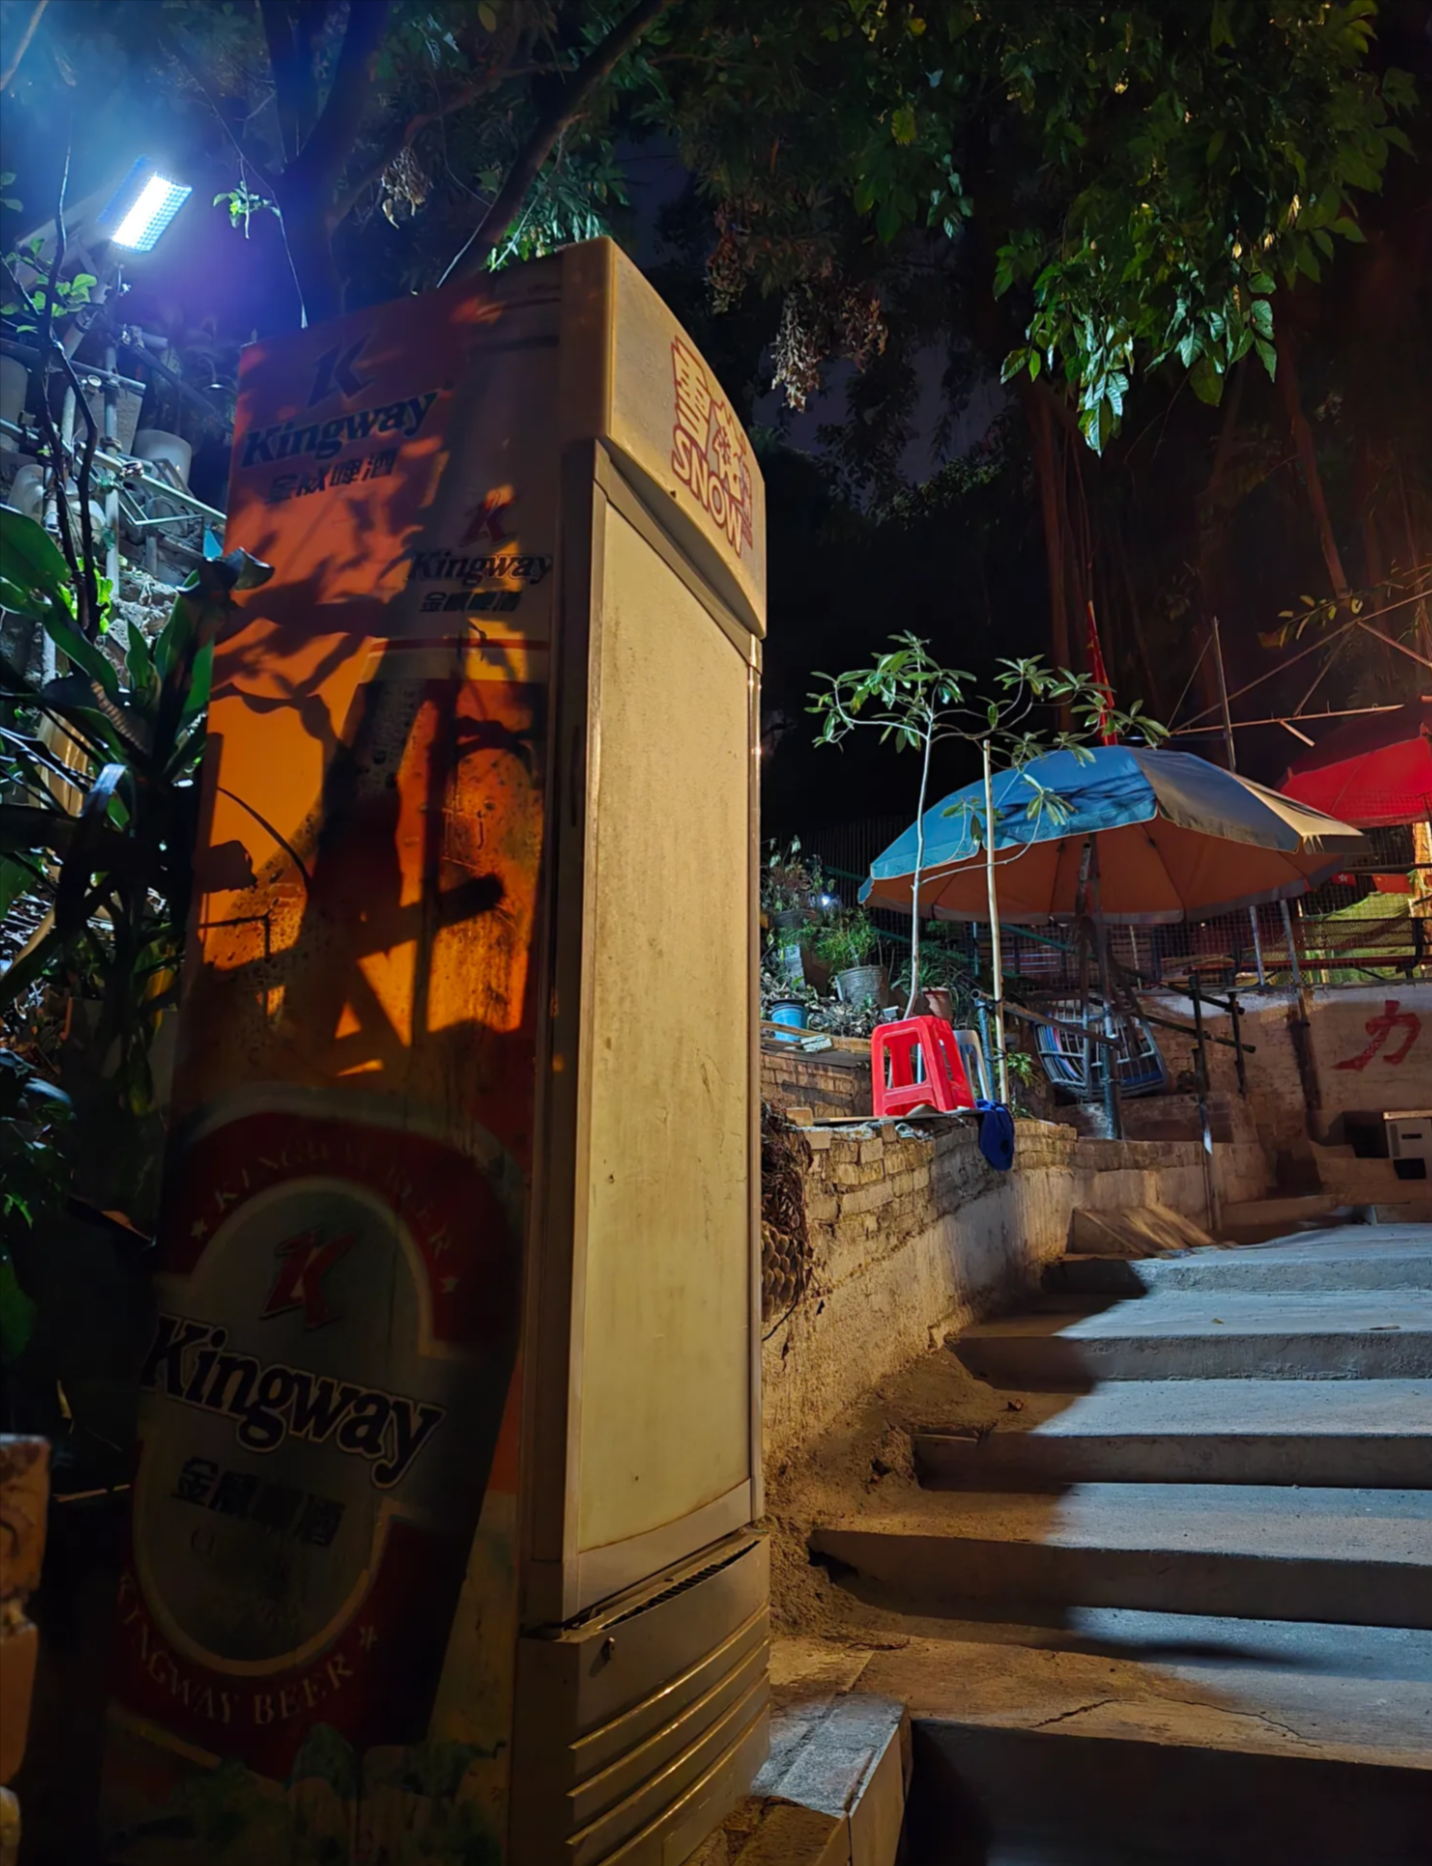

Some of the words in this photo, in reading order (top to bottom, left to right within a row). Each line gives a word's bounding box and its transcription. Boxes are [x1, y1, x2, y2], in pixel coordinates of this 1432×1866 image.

[241, 387, 443, 468] Kingway
[672, 423, 742, 560] SNOW
[407, 550, 553, 585] Kingway
[1333, 1000, 1422, 1072] 力
[140, 1312, 447, 1489] Kingway
